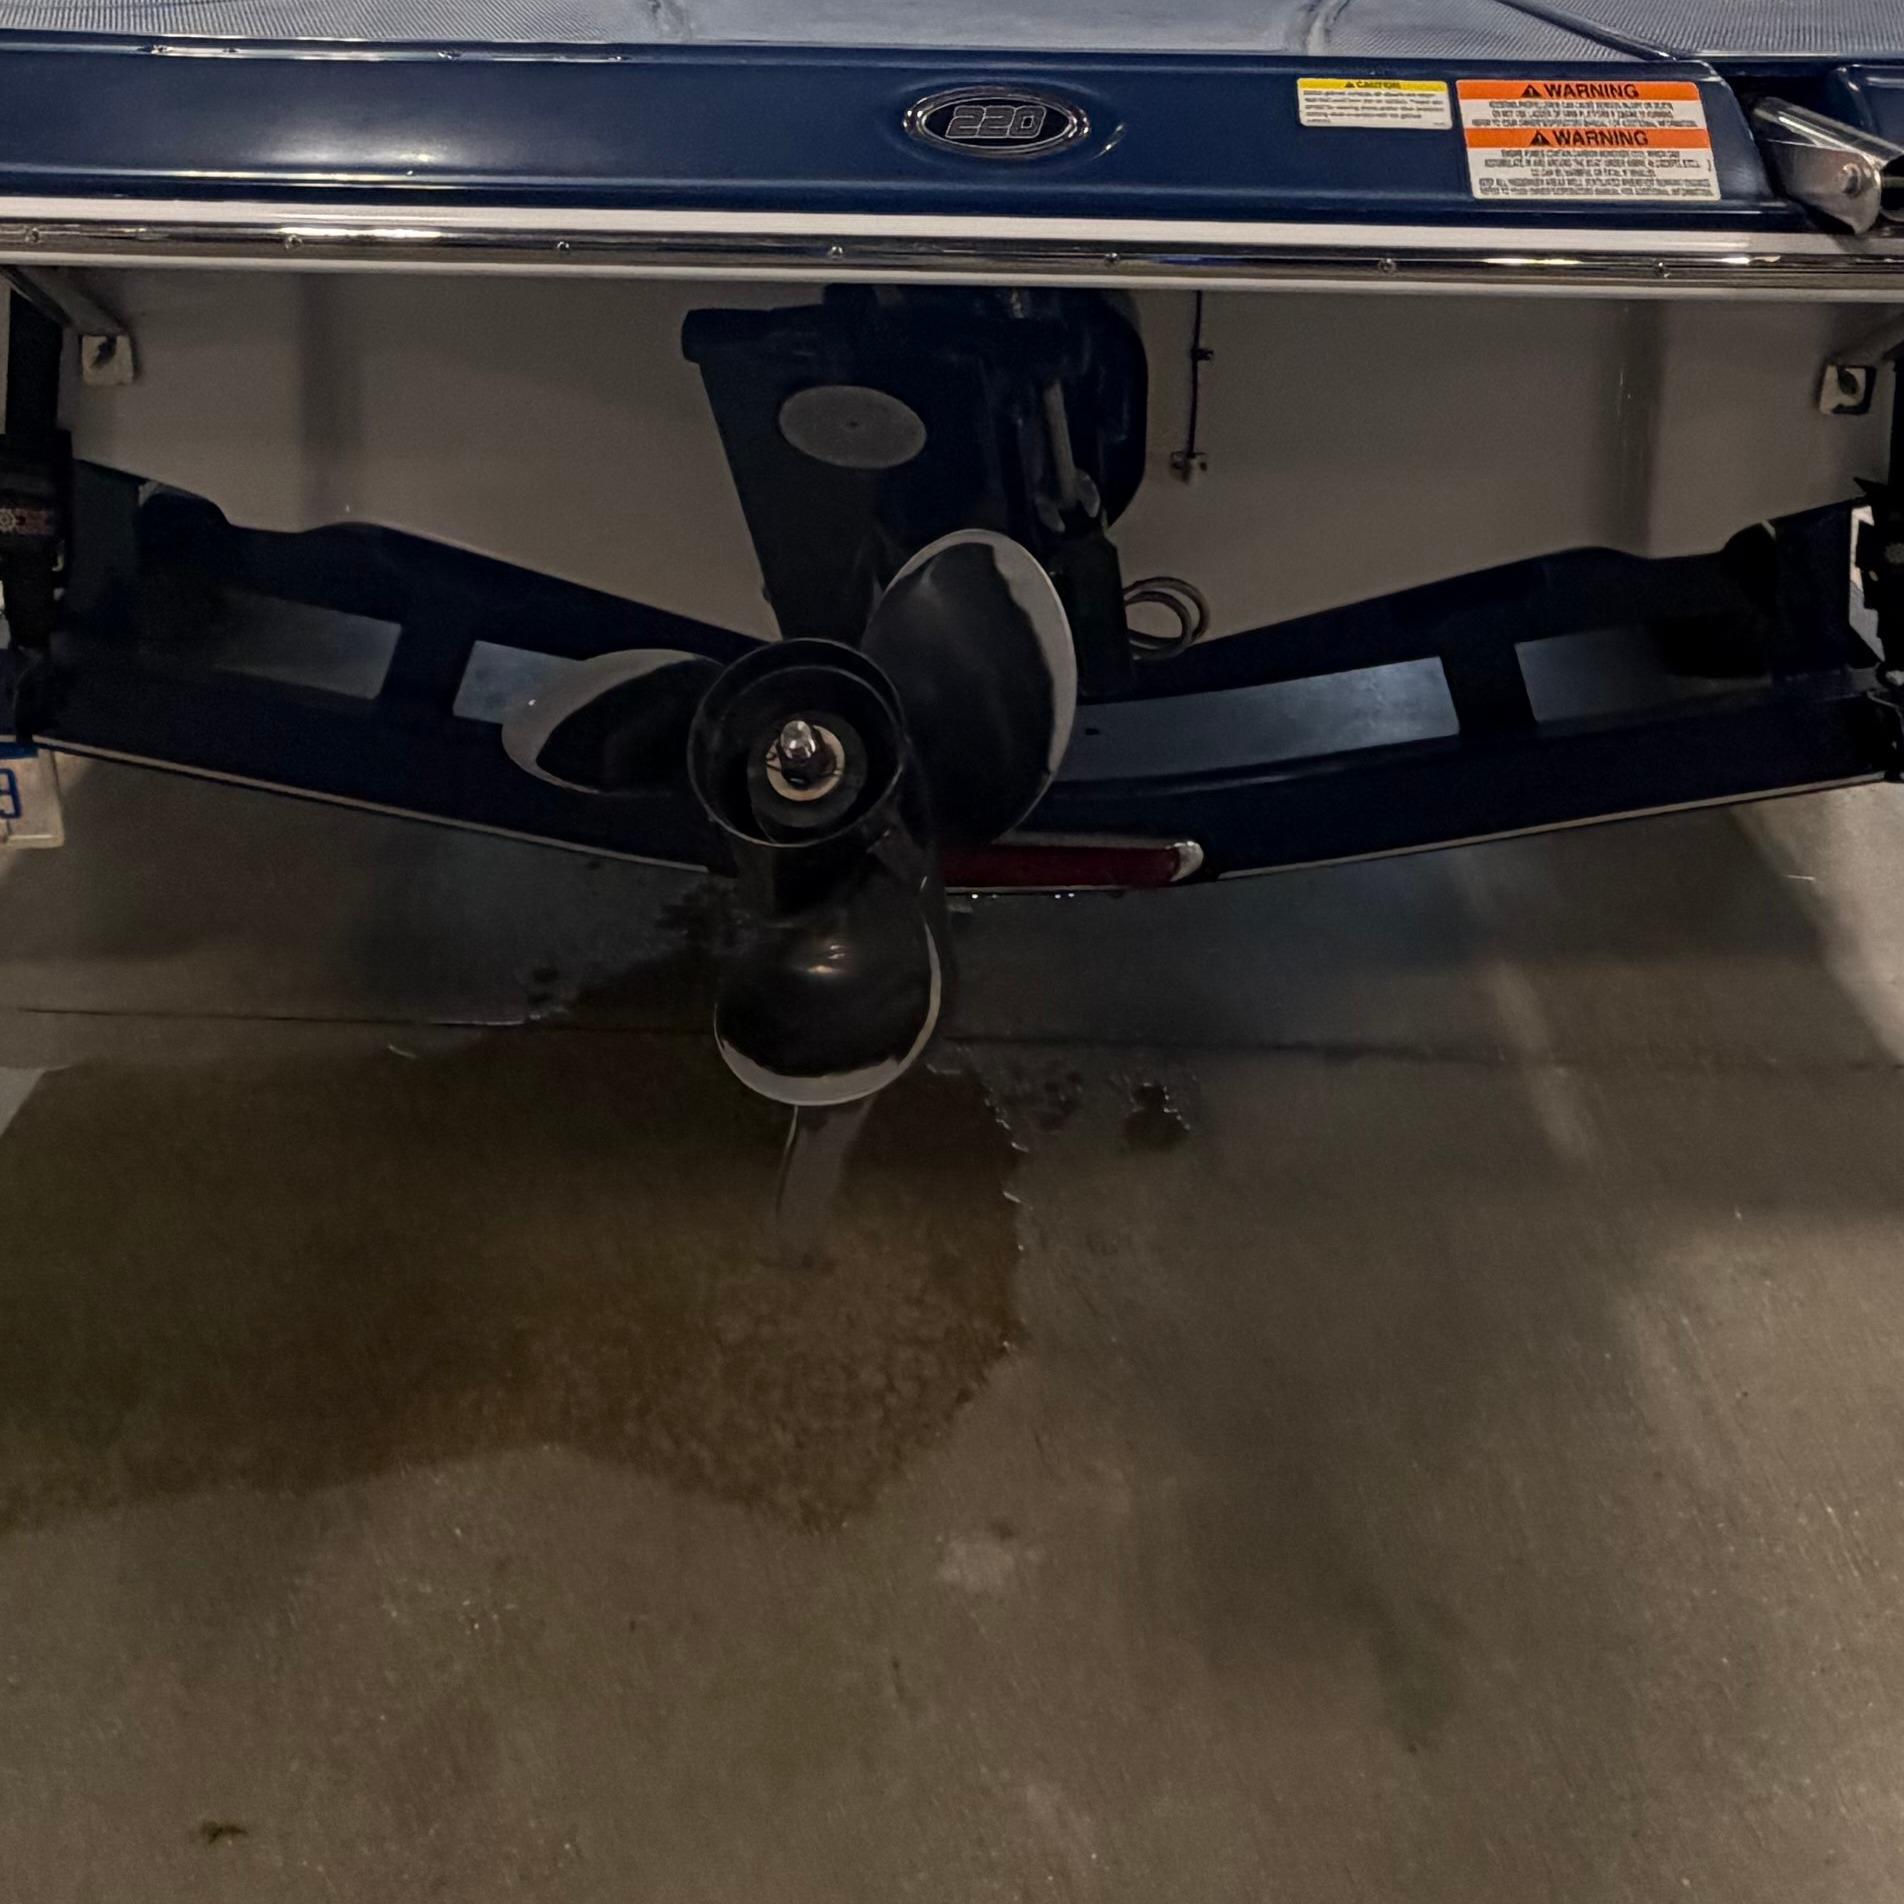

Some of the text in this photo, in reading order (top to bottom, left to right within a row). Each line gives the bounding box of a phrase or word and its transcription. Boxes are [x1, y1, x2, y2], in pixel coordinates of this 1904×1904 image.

[1544, 83, 1640, 100] WARNING
[945, 105, 1047, 139] 220
[1552, 130, 1649, 147] WARNING
